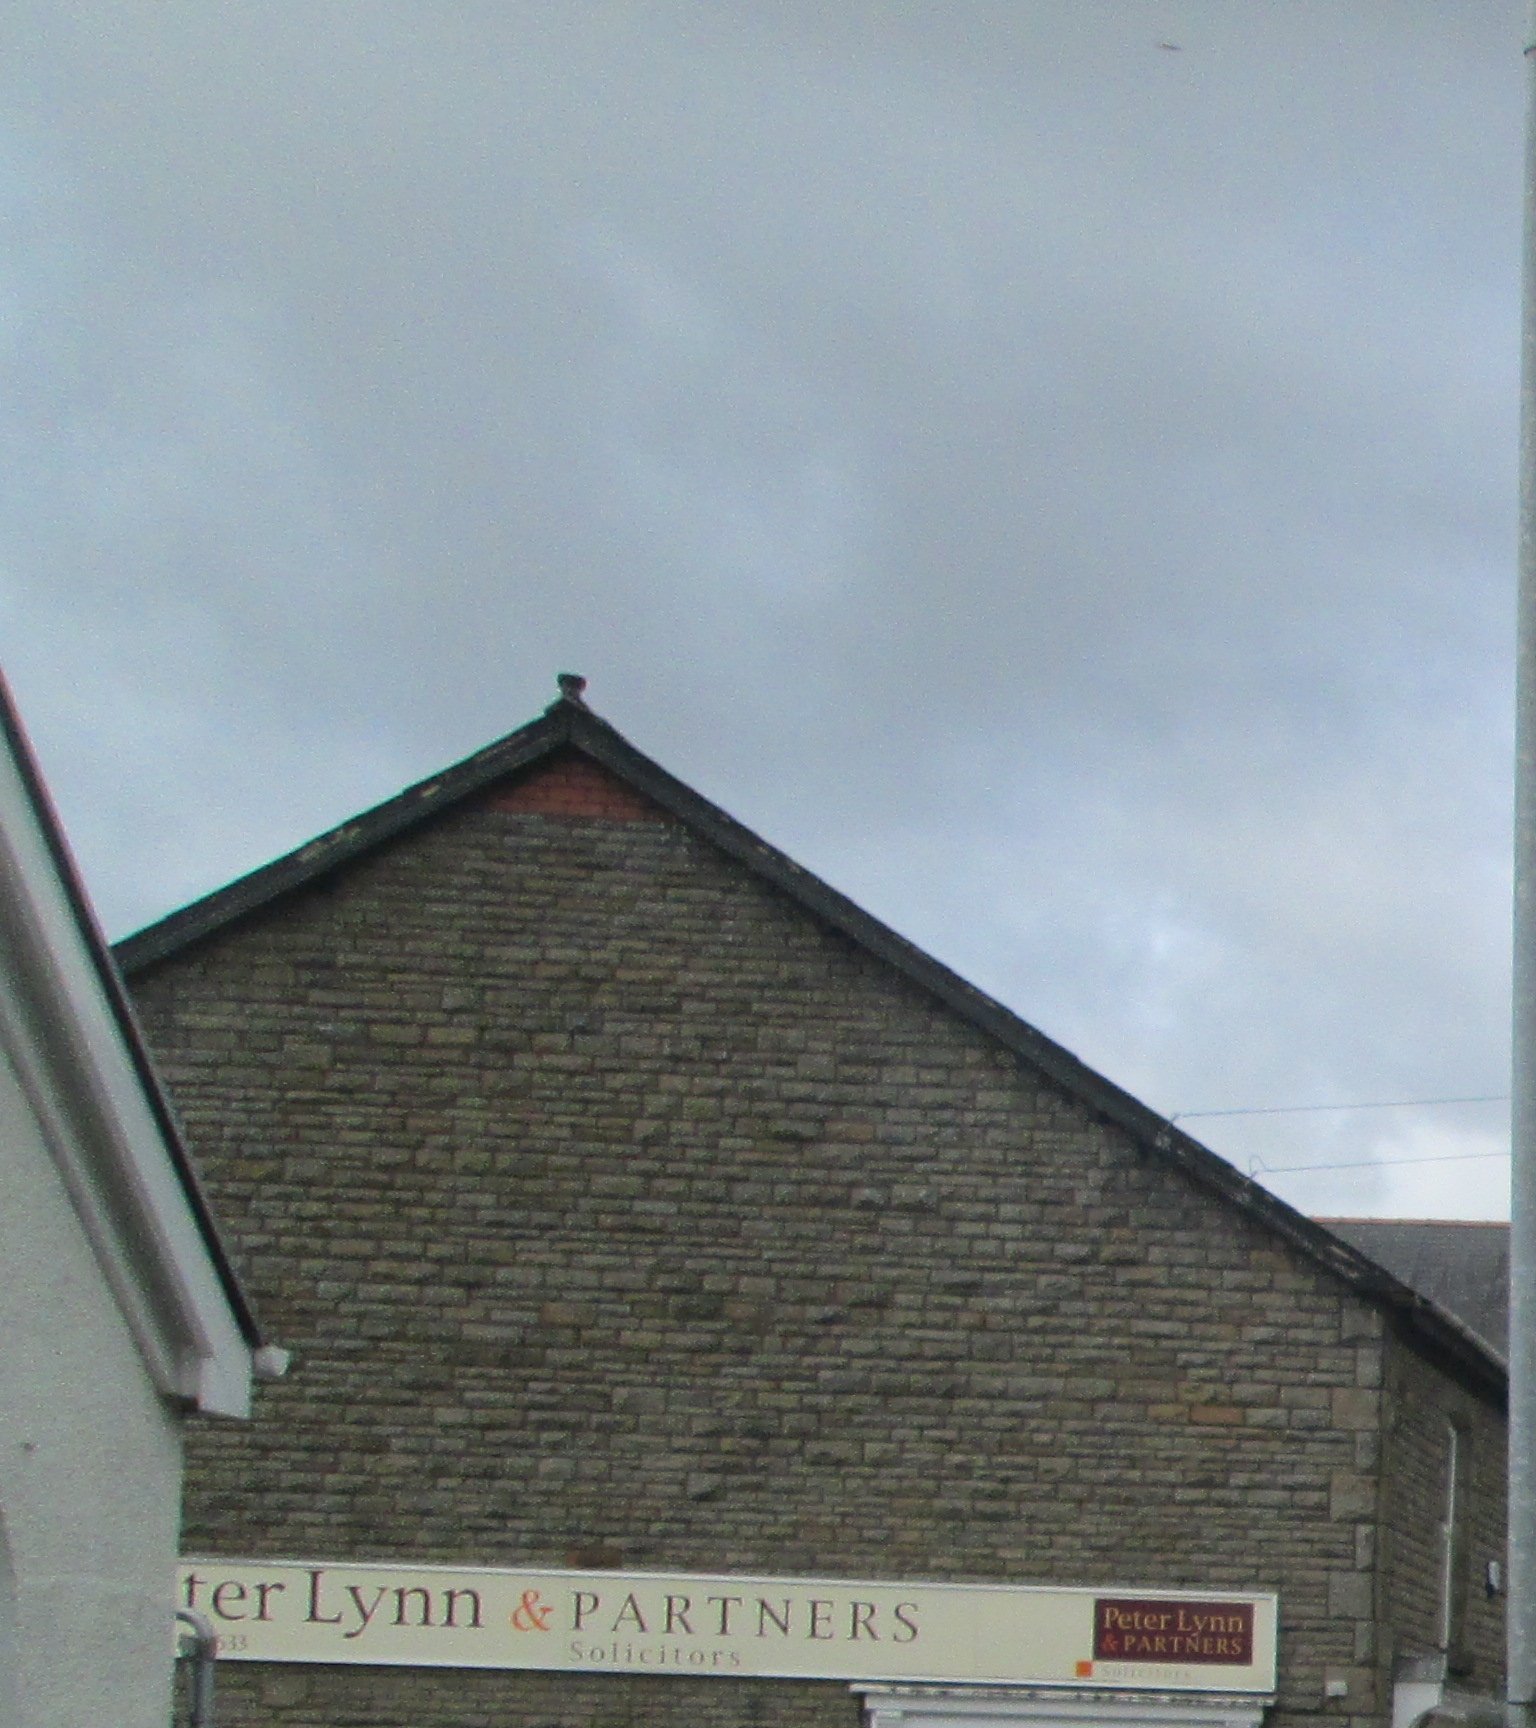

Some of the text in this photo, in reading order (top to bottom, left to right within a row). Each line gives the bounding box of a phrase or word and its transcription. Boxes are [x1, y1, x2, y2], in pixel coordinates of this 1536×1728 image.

[302, 1570, 485, 1638] Lynn
[509, 1589, 554, 1632] &
[570, 1591, 921, 1643] PARTNERS
[1103, 1607, 1244, 1637] Peter Lynn
[569, 1640, 741, 1667] Solicitors
[1102, 1634, 1242, 1655] & PARTNERS
